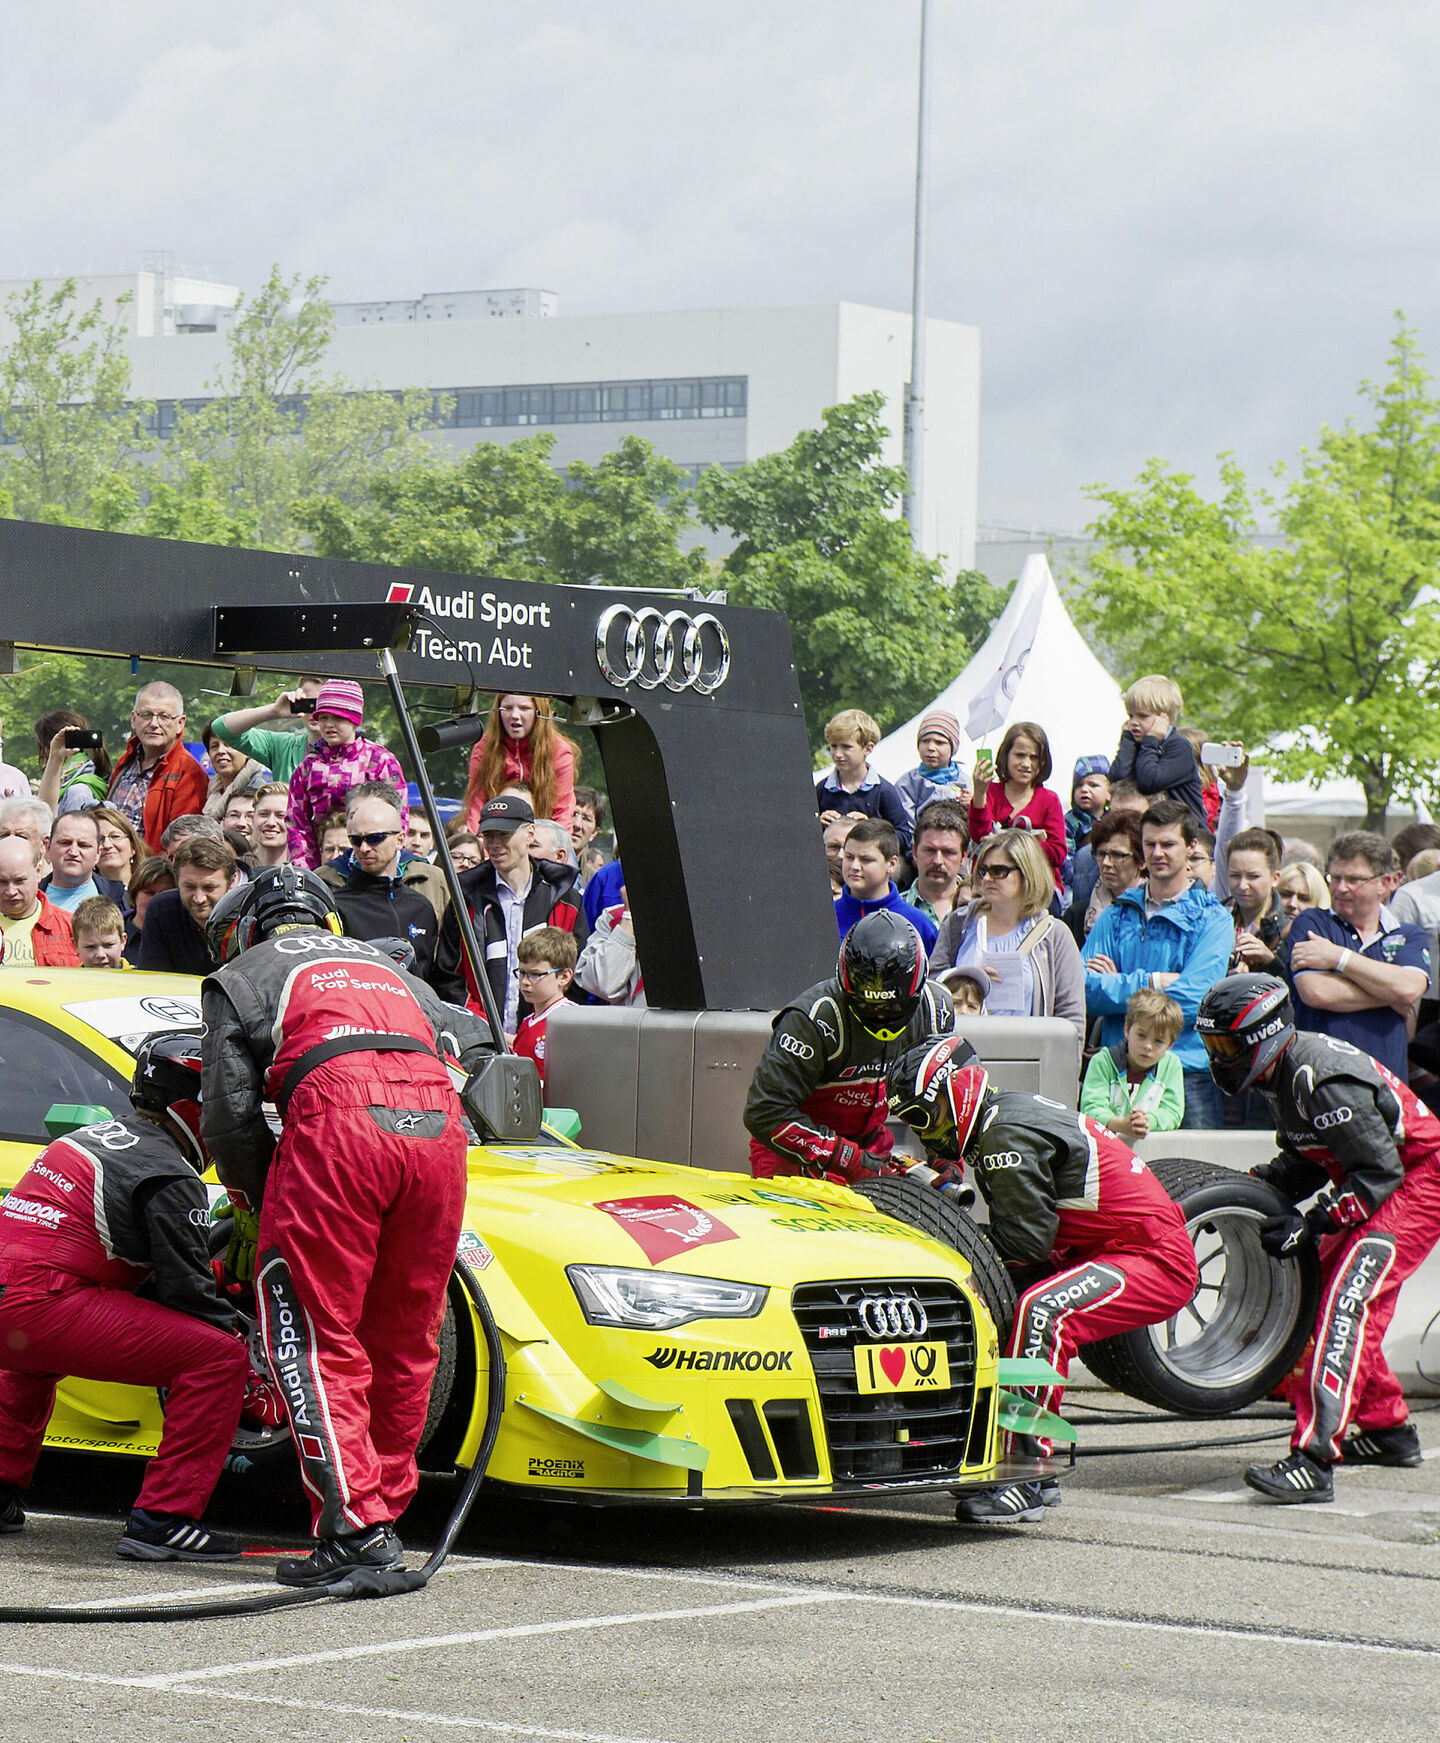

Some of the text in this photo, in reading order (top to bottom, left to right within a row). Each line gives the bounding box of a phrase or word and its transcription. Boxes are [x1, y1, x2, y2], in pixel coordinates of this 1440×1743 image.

[418, 586, 551, 630] Audi Sport
[416, 629, 533, 669] Team Abt
[311, 968, 350, 985] Audi
[313, 978, 408, 998] Top Service
[864, 989, 897, 1000] uvex
[1246, 1017, 1285, 1045] uvex
[923, 1058, 958, 1103] uvex
[33, 1161, 74, 1193] Service
[1024, 1274, 1101, 1359] Audi Sport
[1326, 1254, 1377, 1368] Audi Sport
[271, 1283, 311, 1426] Audi Sport
